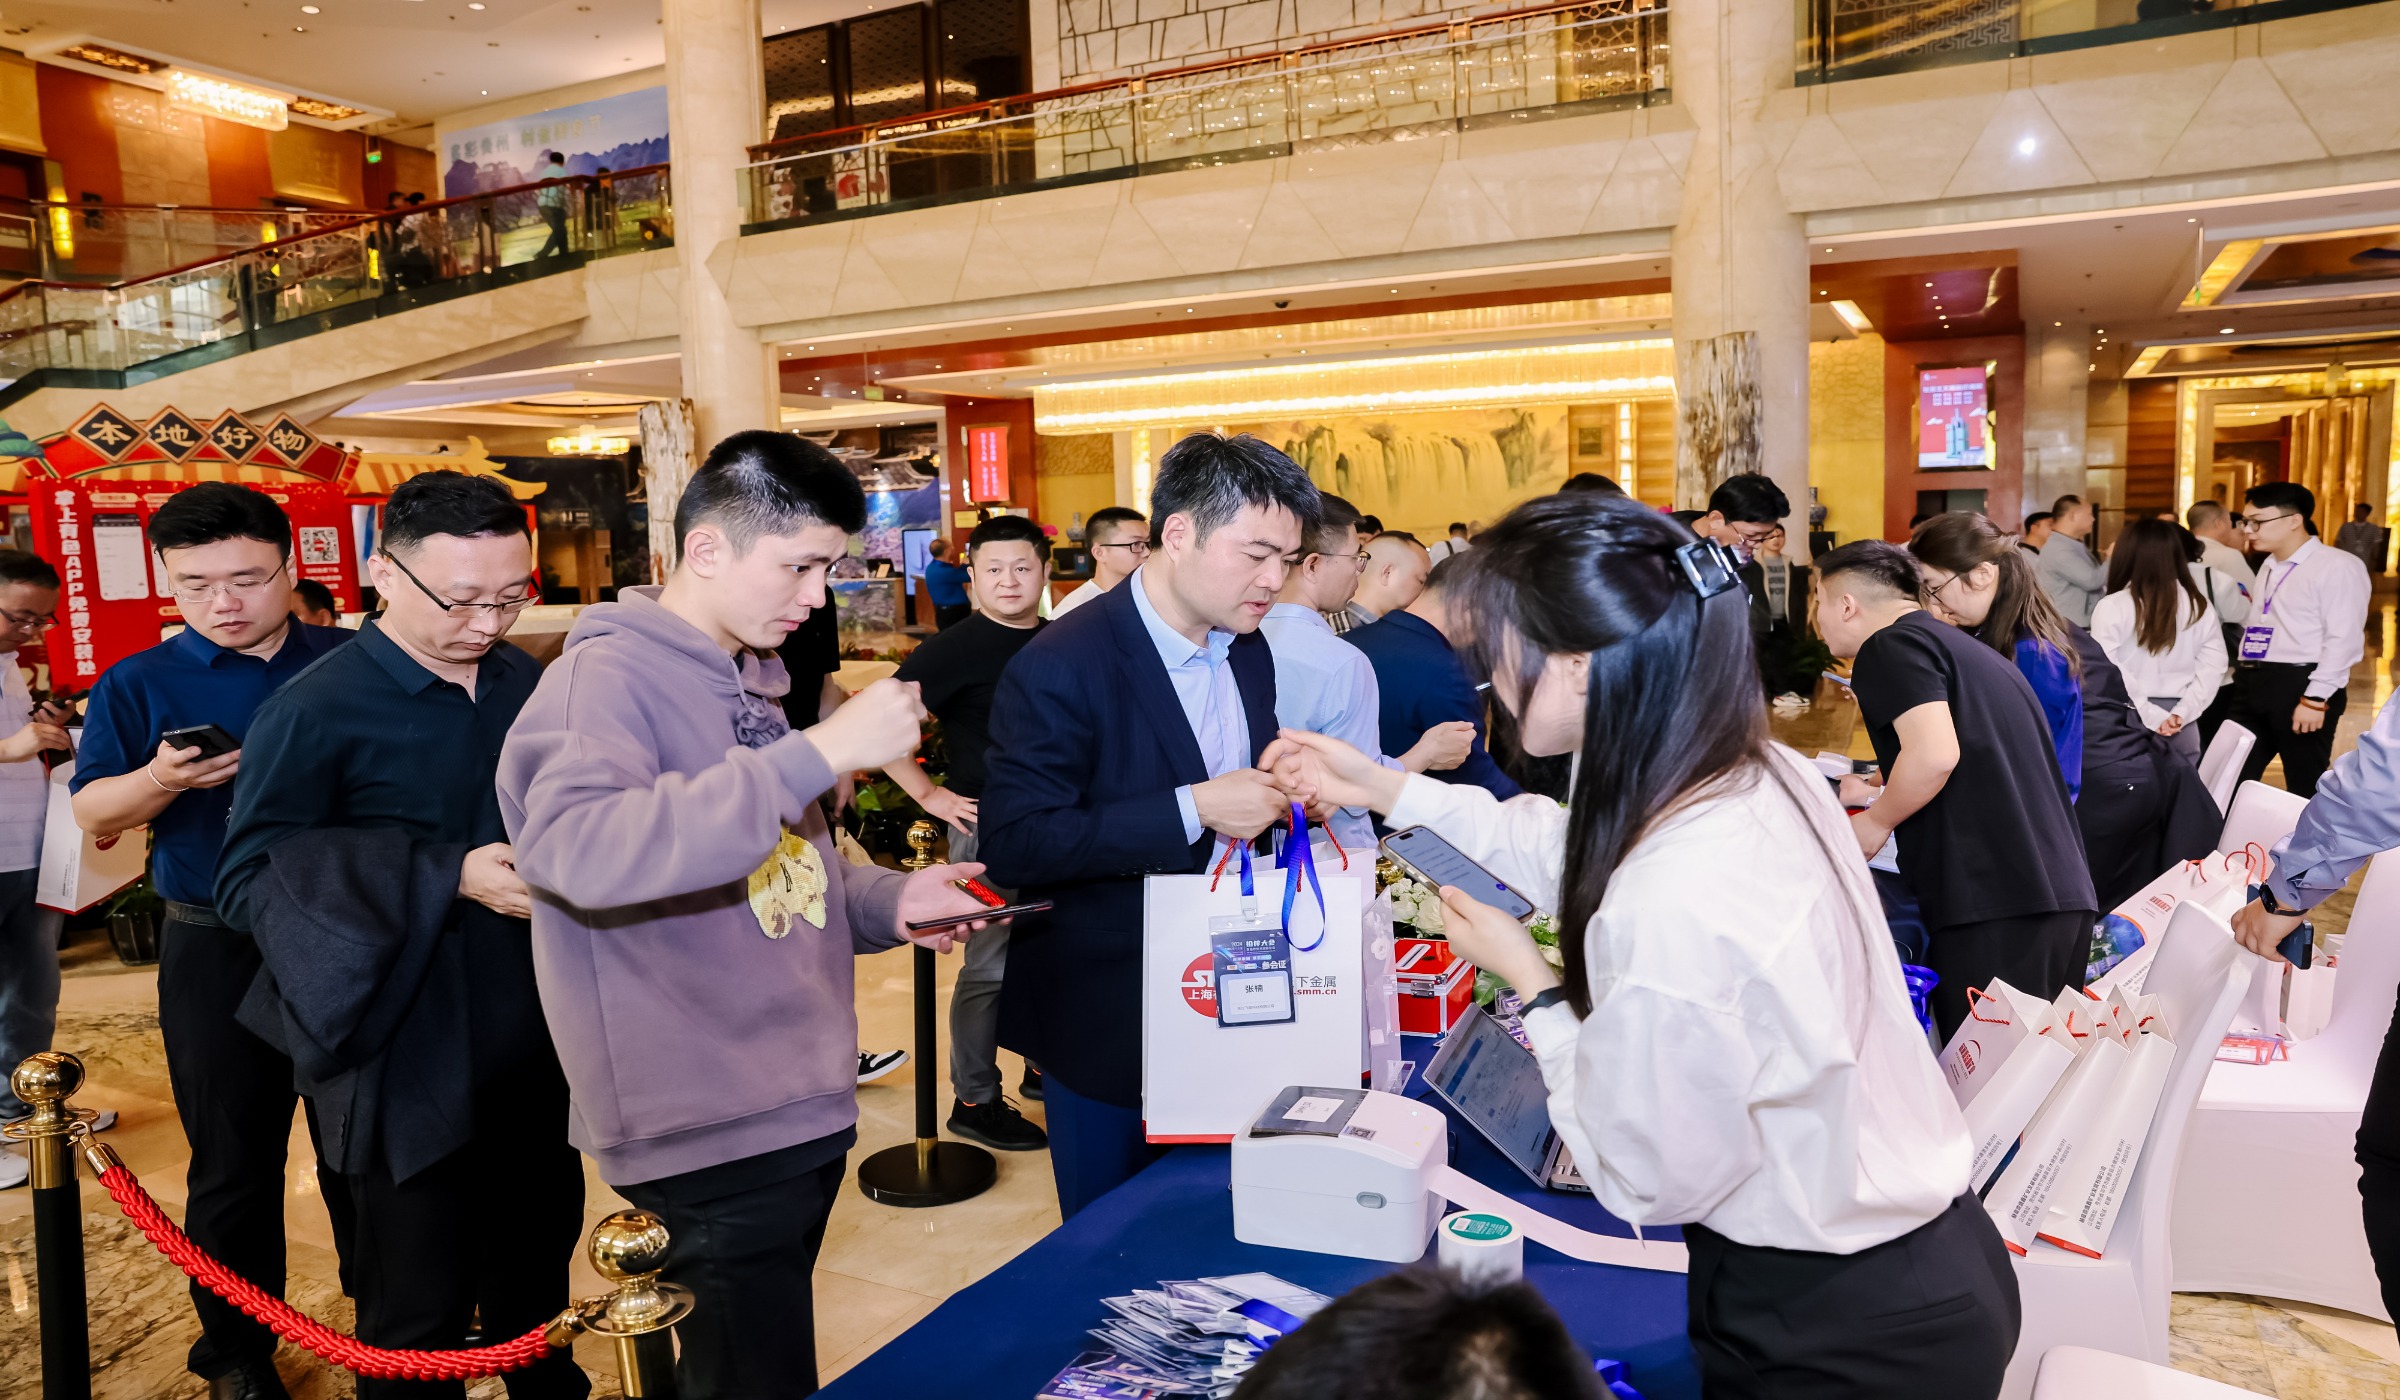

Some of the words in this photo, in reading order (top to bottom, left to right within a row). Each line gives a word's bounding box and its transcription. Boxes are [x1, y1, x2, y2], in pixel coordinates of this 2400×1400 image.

[88, 419, 307, 452] 本地好物
[54, 490, 97, 676] 掌上有色APP免费安装处
[1262, 960, 1287, 970] 参会证
[1293, 975, 1337, 988] 下金属
